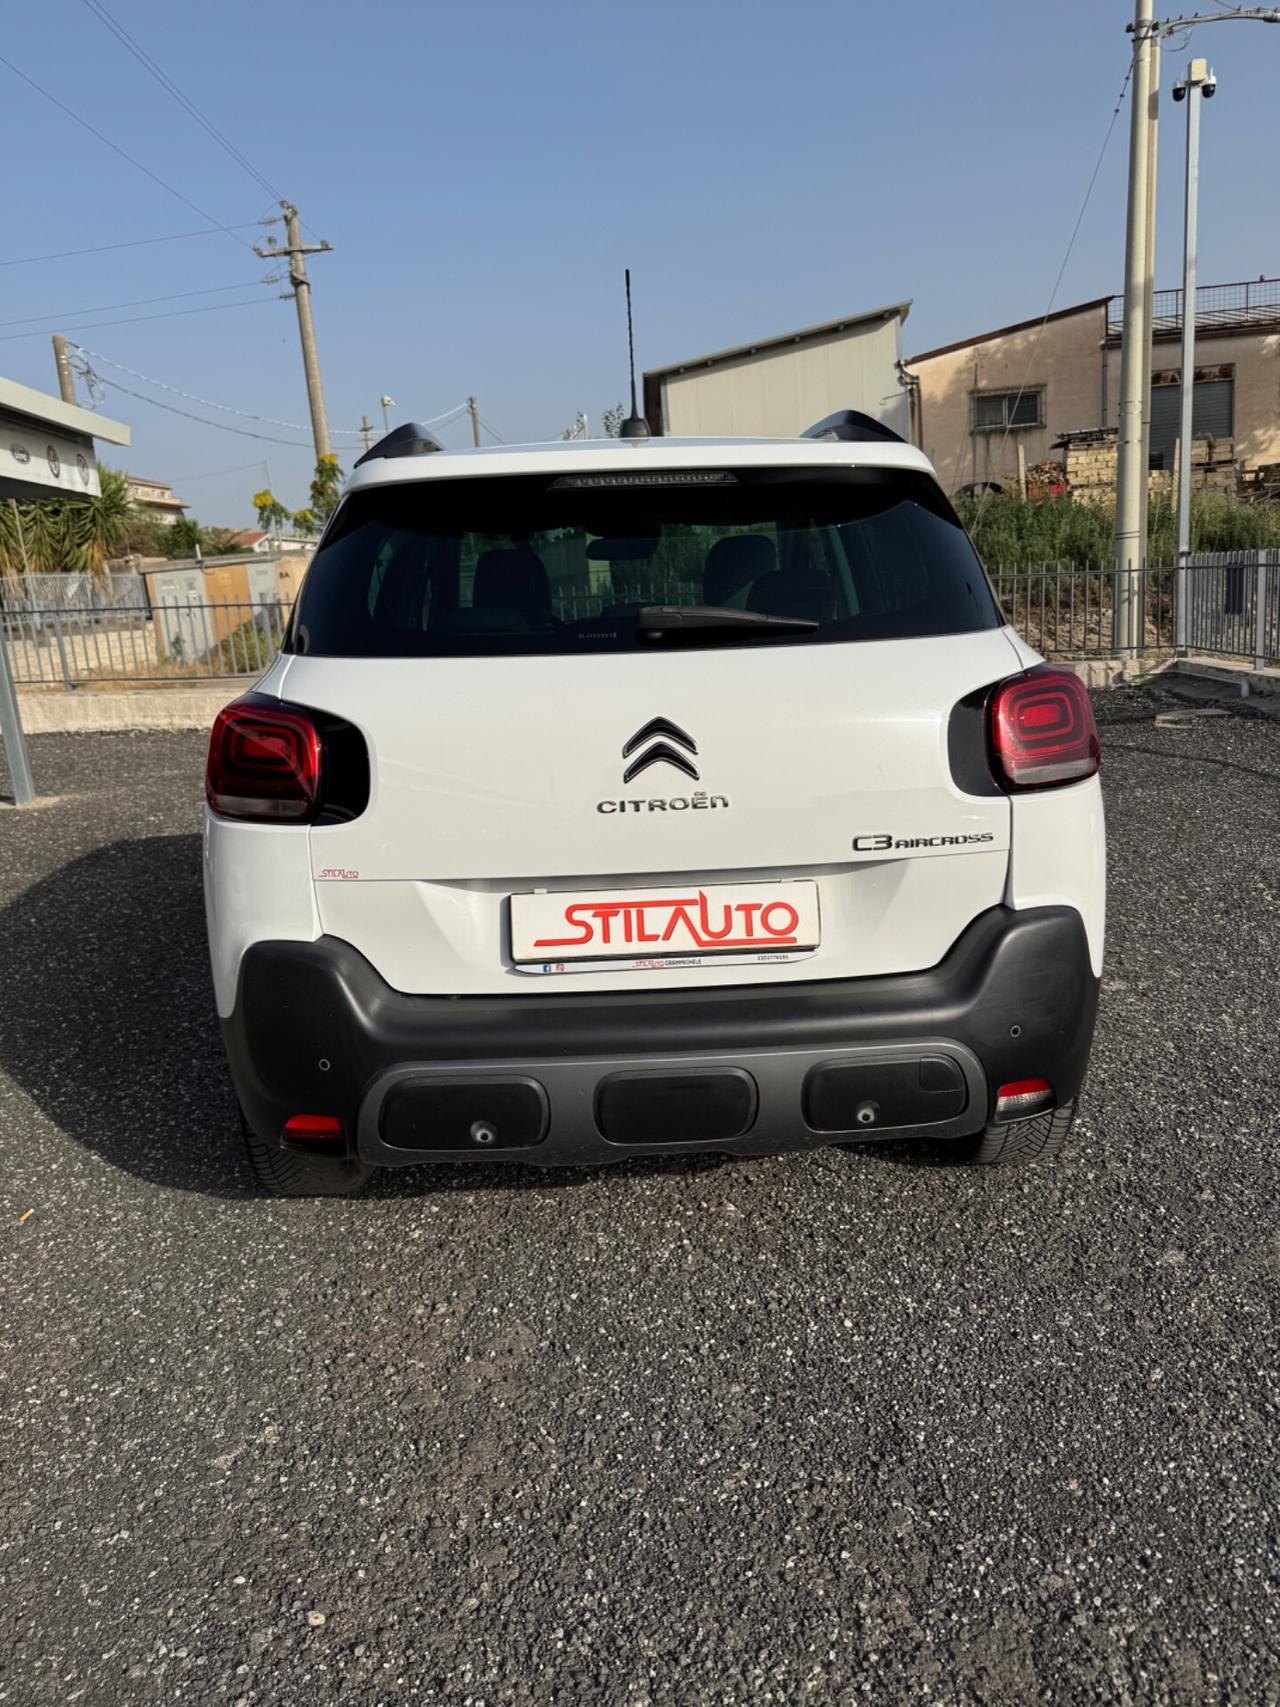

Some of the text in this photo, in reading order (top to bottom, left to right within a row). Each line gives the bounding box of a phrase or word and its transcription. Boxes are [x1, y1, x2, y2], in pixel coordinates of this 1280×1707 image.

[596, 791, 729, 814] CITROËN
[852, 832, 994, 851] C3 AIRCROSS
[534, 890, 799, 947] STILAUTO
